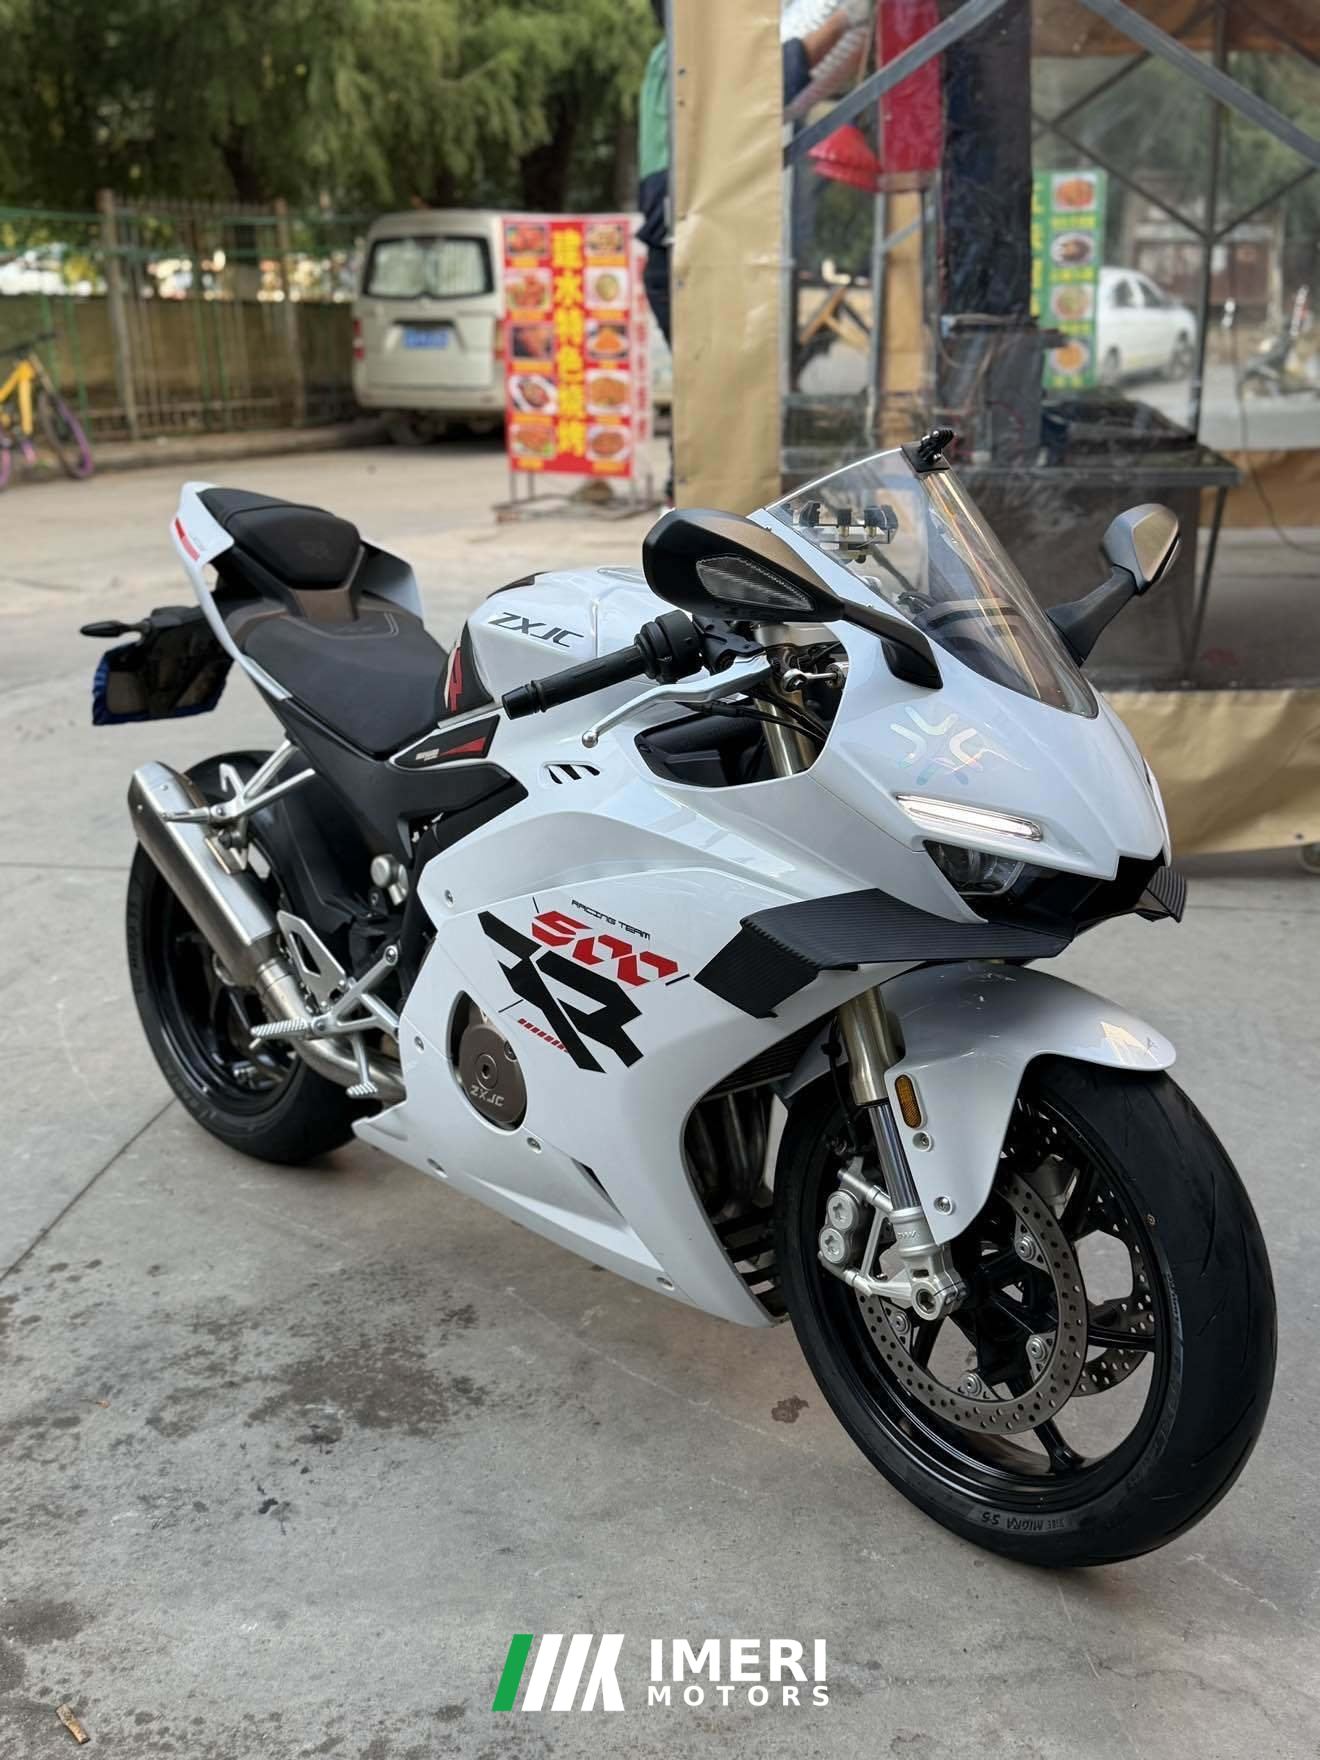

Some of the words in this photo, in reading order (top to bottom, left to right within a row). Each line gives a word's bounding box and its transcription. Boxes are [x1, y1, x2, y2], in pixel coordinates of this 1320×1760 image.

[488, 611, 584, 648] ZXJC
[571, 899, 617, 926] RACING
[618, 920, 651, 941] TEAM
[531, 910, 679, 987] 500
[470, 1084, 505, 1107] ZXJC
